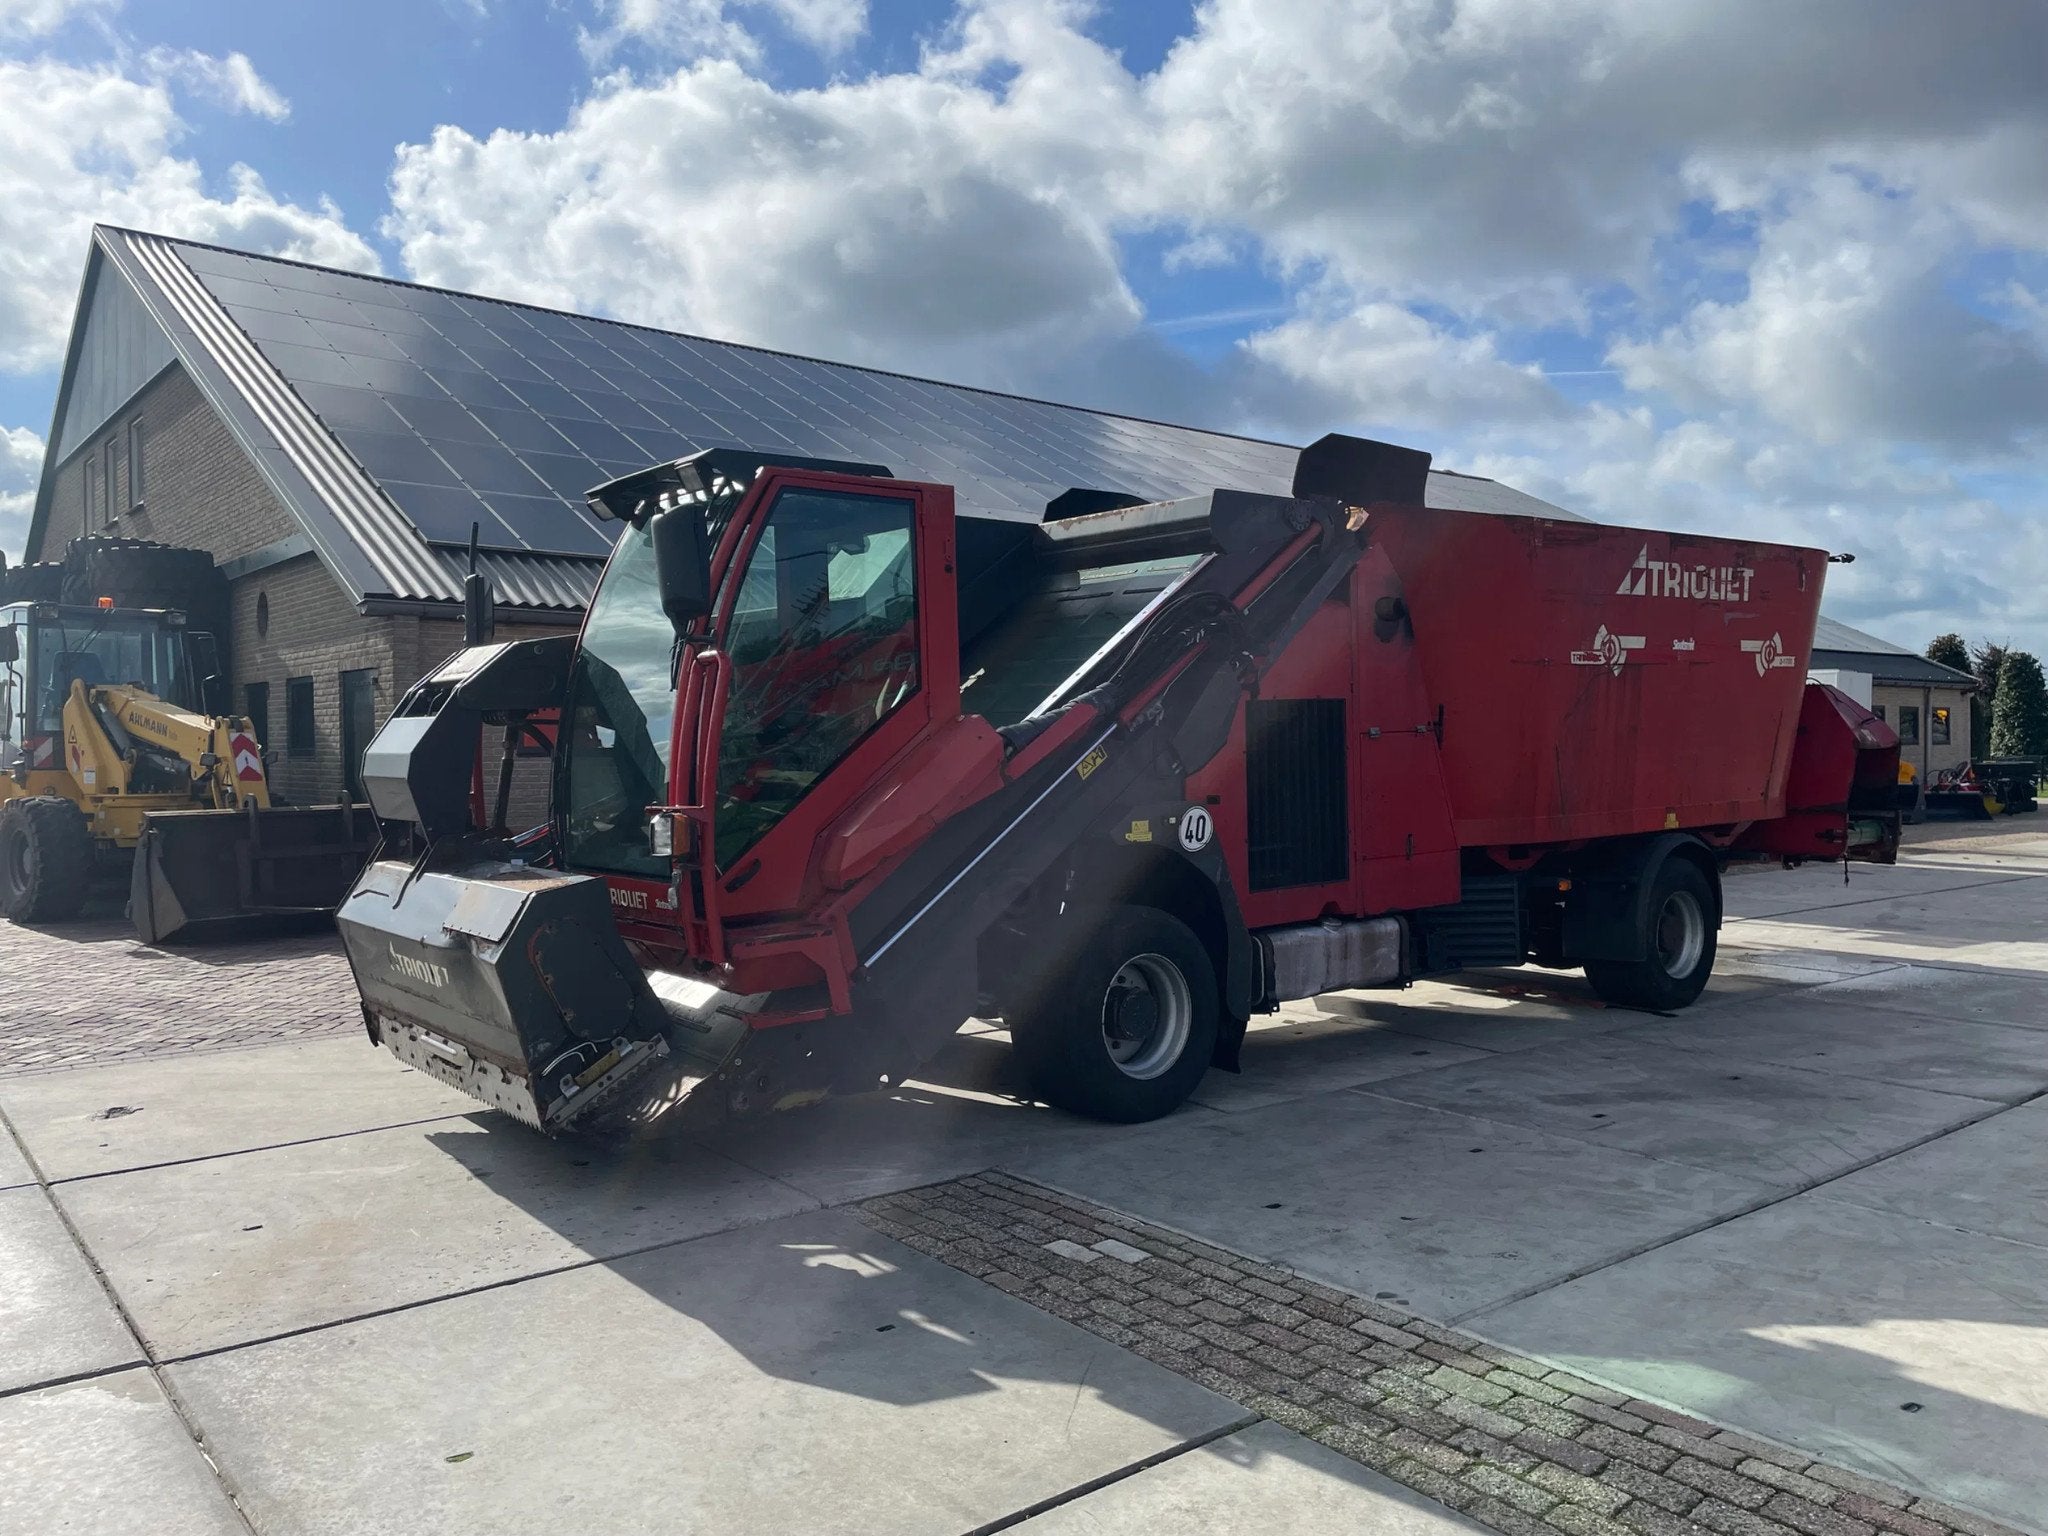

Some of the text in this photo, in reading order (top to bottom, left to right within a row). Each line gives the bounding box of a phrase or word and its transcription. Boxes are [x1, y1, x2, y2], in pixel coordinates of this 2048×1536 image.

[1648, 561, 1754, 602] TRIOLIET
[128, 711, 168, 737] AHLMANN
[1185, 814, 1206, 843] 40
[609, 887, 648, 910] RIOLIET
